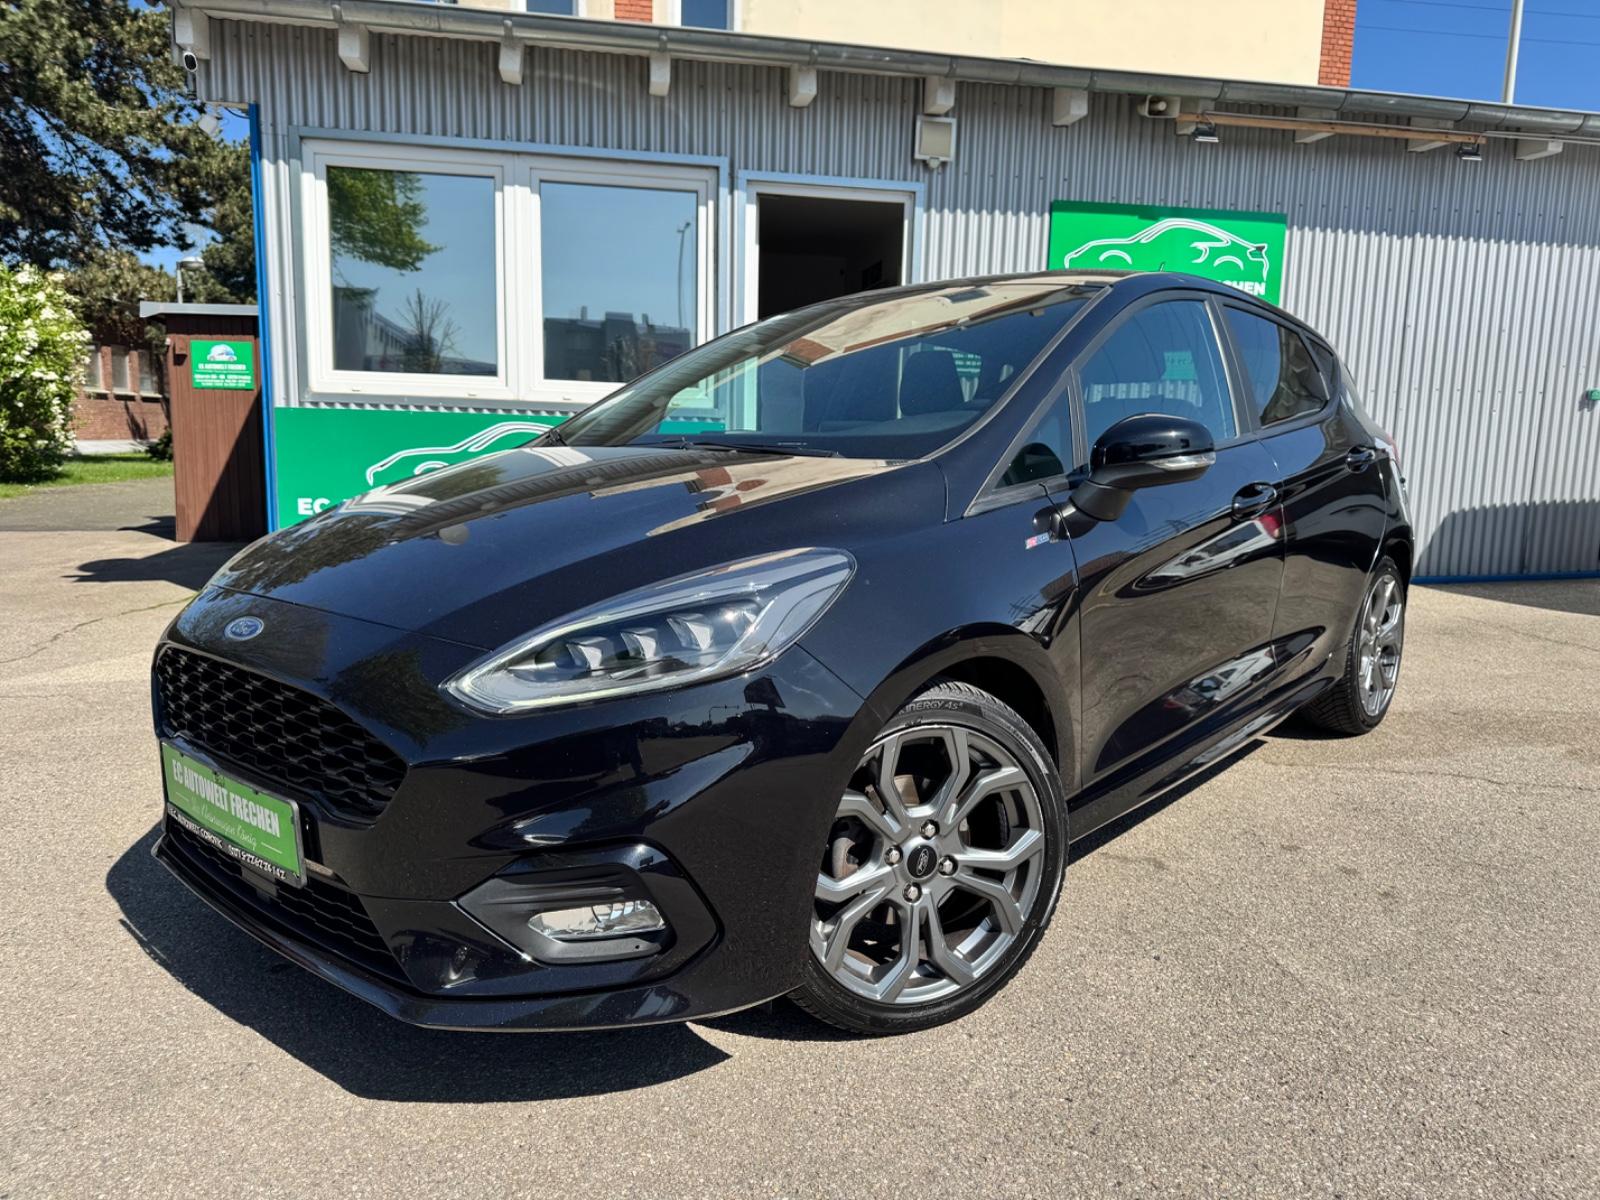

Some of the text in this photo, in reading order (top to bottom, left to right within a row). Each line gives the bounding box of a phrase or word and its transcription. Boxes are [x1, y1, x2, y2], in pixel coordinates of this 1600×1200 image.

[297, 497, 331, 516] EC
[172, 759, 184, 785] EC
[183, 766, 229, 812] AUTOWELT
[229, 792, 281, 838] FRECHEN
